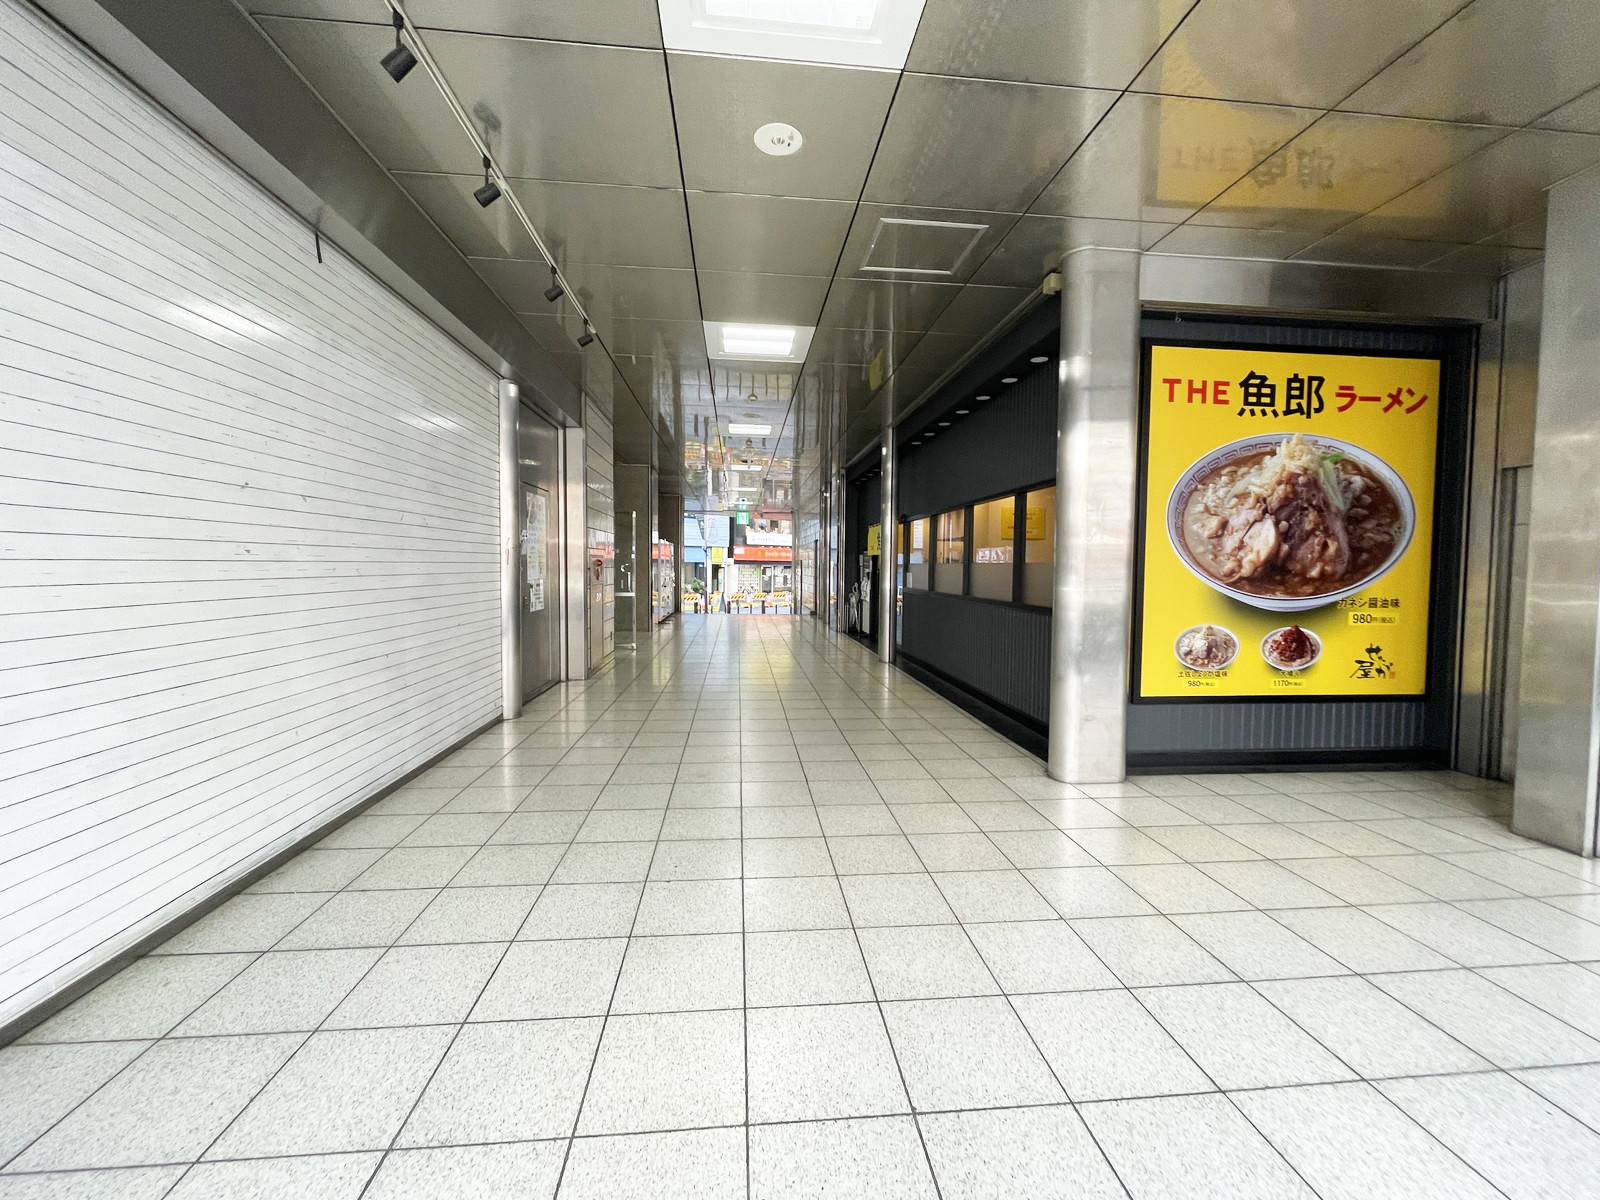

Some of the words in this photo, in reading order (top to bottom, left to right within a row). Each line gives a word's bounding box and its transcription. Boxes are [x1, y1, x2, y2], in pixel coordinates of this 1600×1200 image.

[1162, 377, 1230, 405] THE
[1237, 370, 1325, 419] 魚郎
[1335, 385, 1429, 414] ラーメン
